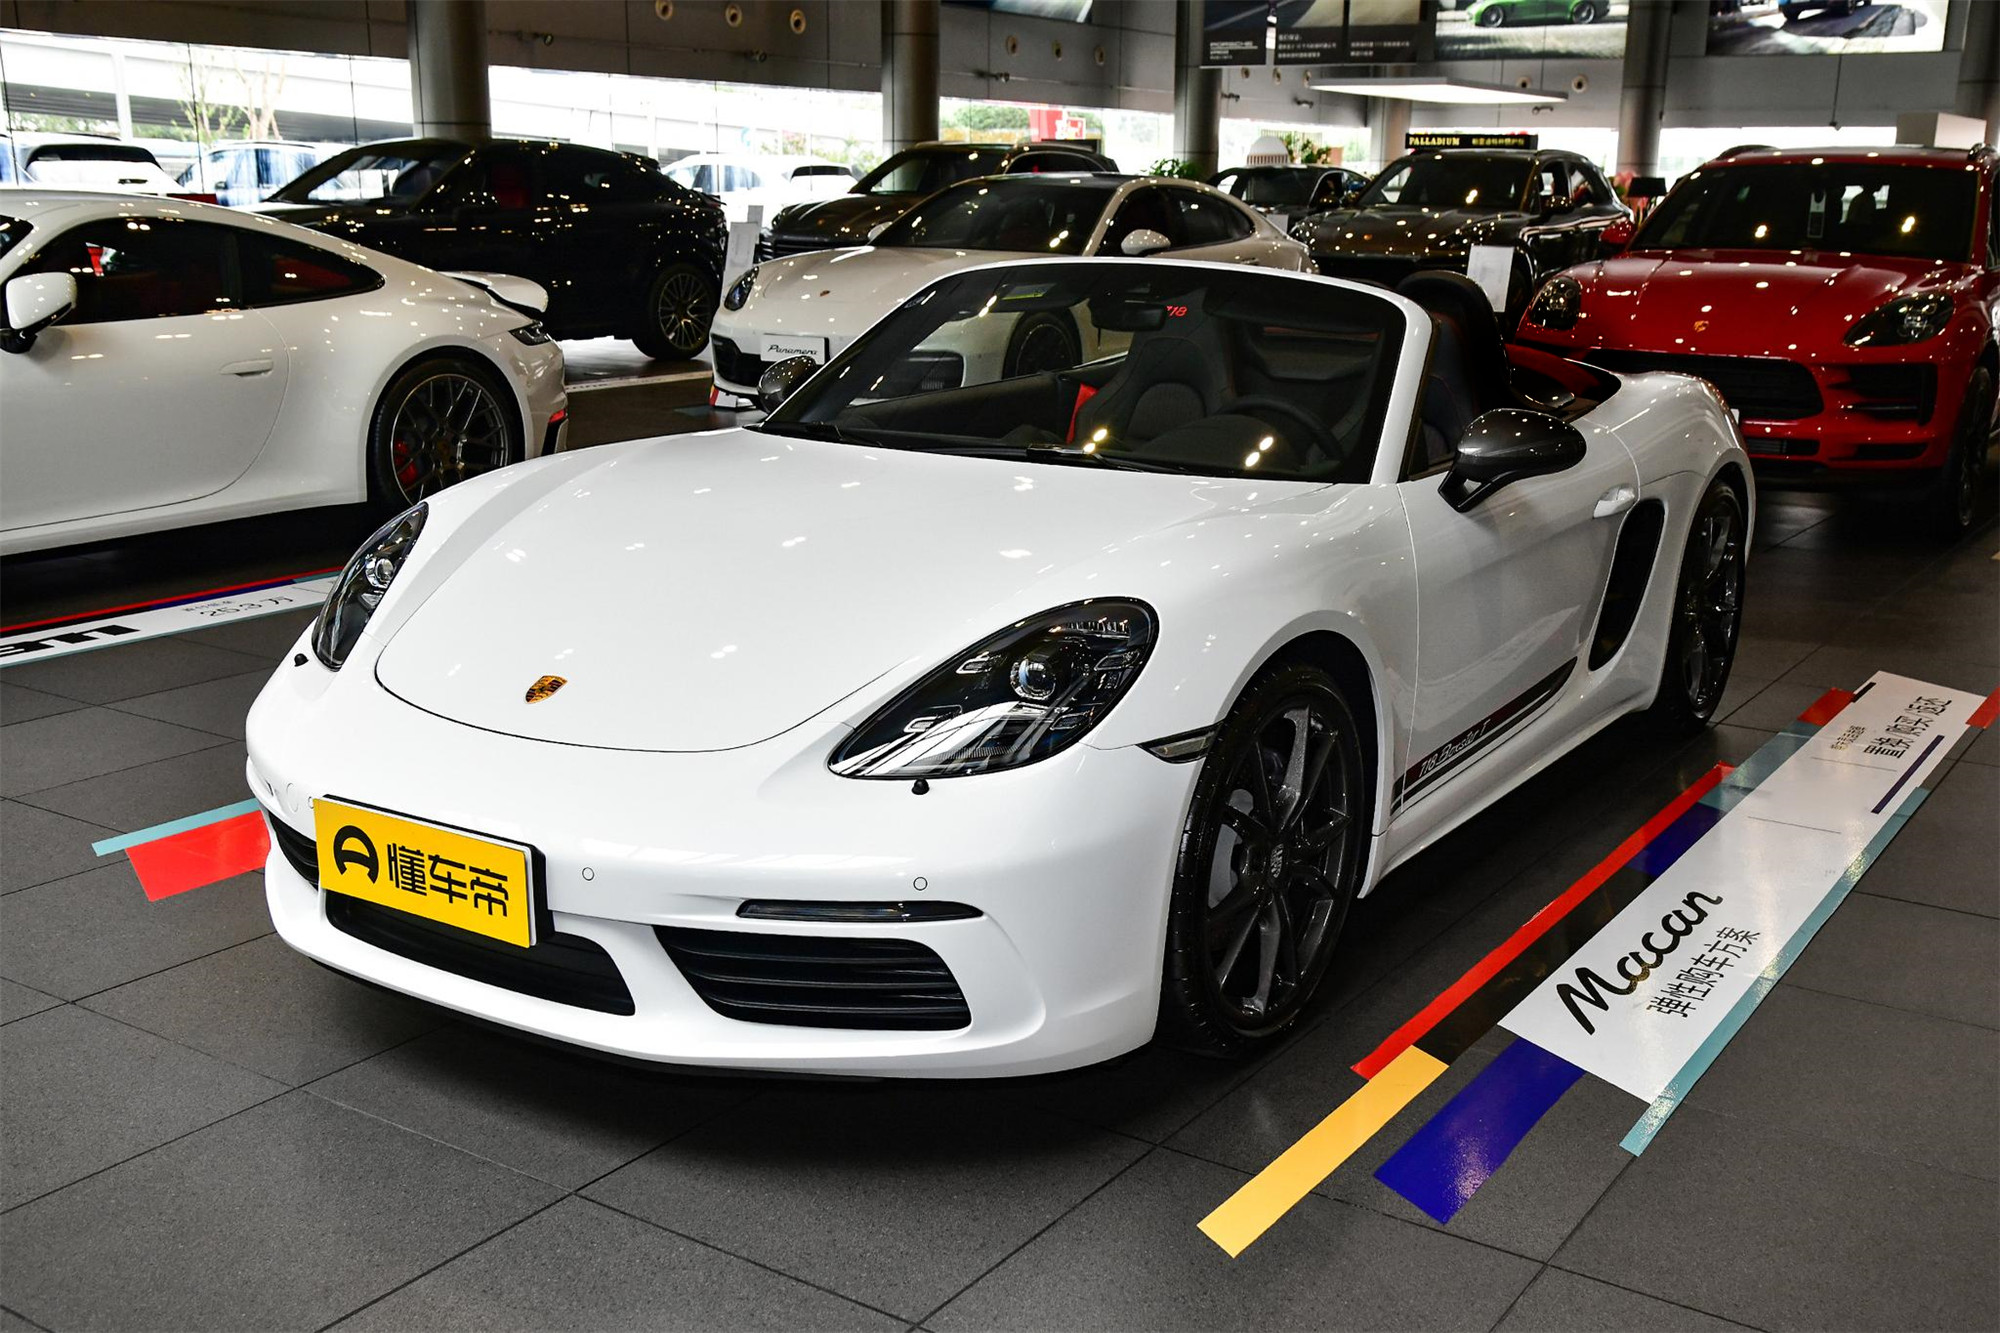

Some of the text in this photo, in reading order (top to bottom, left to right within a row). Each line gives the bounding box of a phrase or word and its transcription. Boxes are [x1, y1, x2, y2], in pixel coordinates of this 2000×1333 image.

[1408, 136, 1460, 147] PALLADIUM
[767, 344, 818, 355] Panamera
[1419, 753, 1438, 778] 718
[387, 842, 509, 917] 懂车帝
[1556, 891, 1724, 1036] Macan
[1646, 926, 1761, 1018] 弹性购车方案
